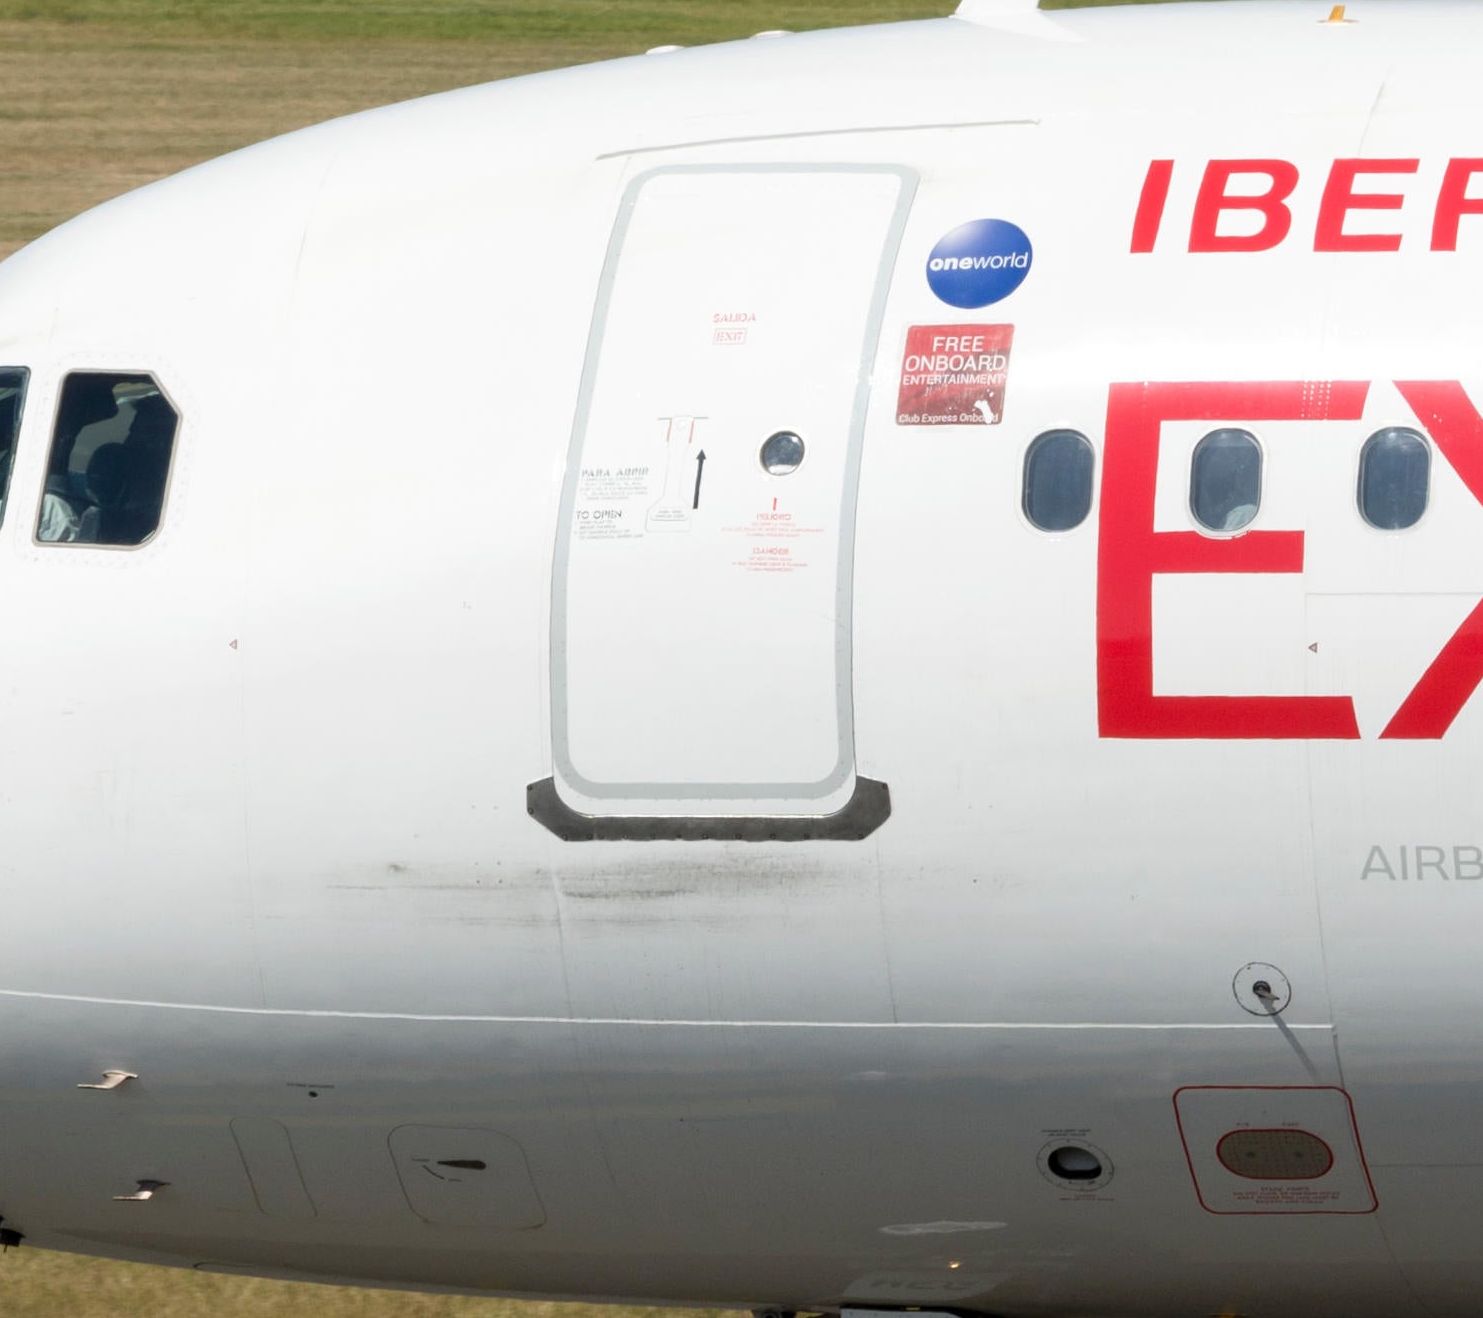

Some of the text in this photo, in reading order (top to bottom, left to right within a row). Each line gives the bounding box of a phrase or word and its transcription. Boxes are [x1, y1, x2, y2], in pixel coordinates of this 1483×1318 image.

[929, 252, 1029, 271] oneworld
[932, 335, 985, 352] FREE
[905, 354, 1007, 372] ONBOARD
[902, 374, 1006, 386] ENTERTAINMENT
[899, 413, 920, 423] Club
[922, 413, 958, 424] Express
